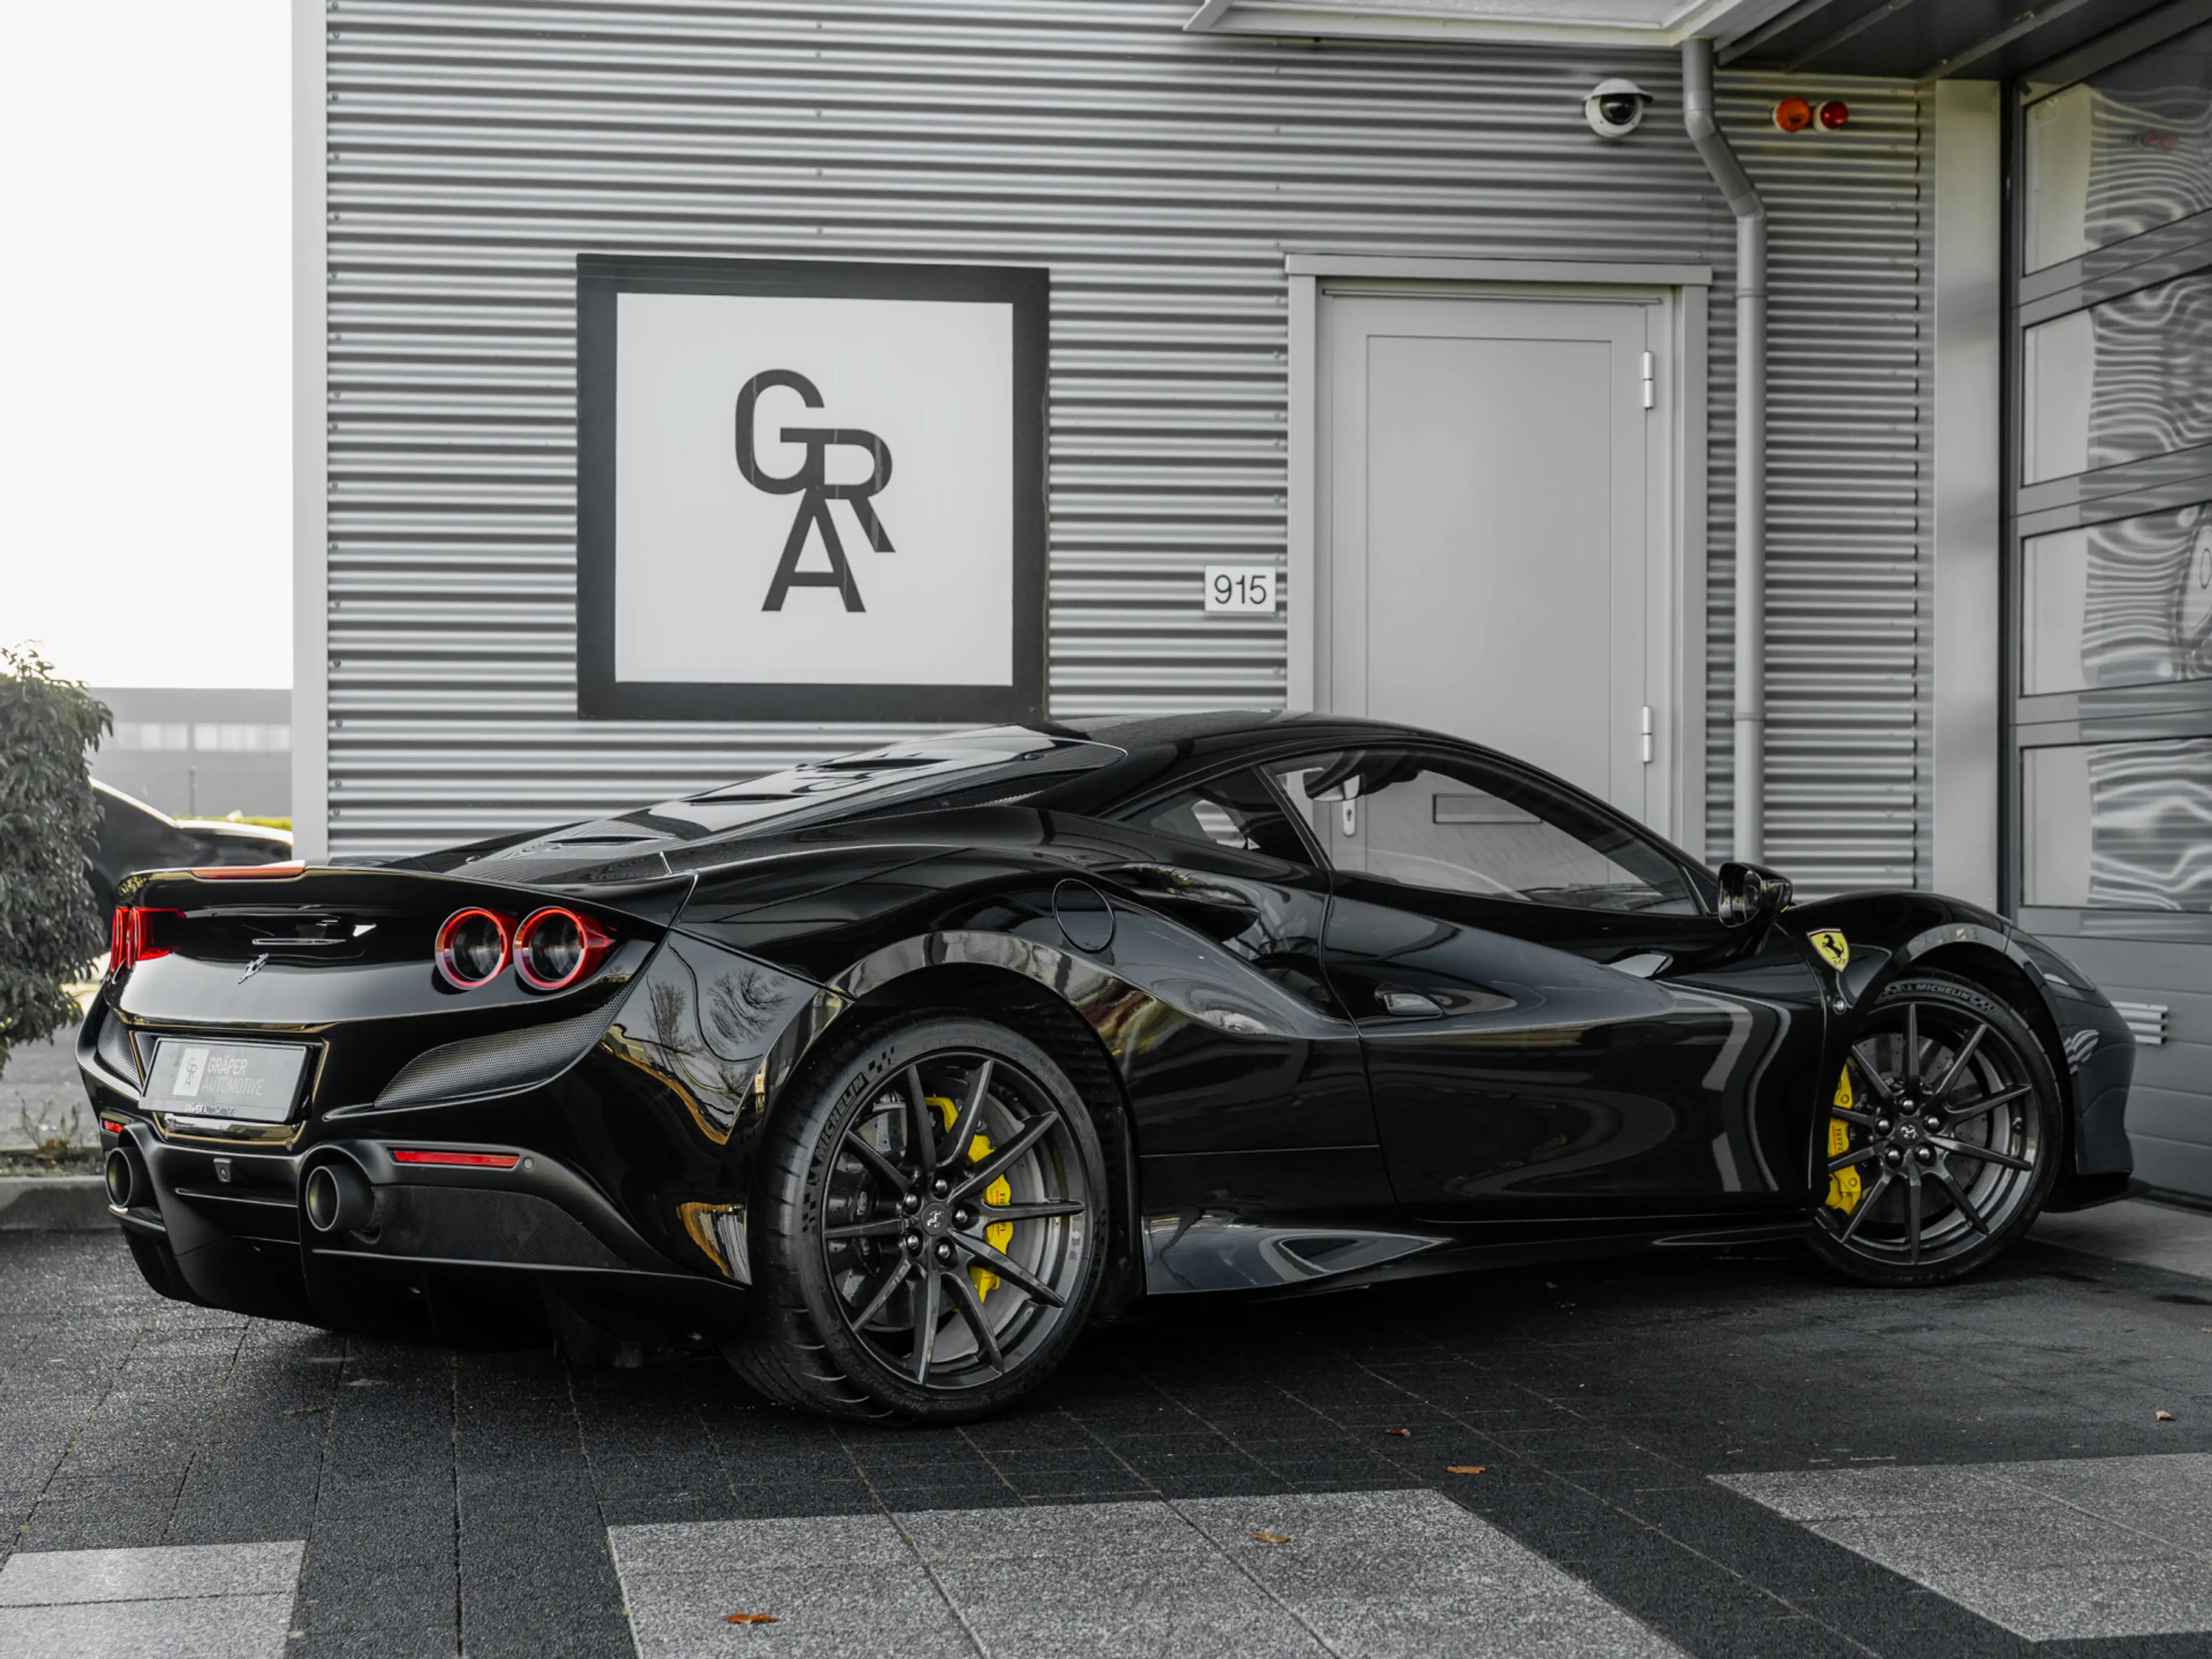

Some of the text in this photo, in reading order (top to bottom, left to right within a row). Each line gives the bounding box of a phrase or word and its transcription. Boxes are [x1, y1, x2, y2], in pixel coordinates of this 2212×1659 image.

[1214, 574, 1266, 605] 915
[1916, 984, 1971, 1000] MICHELIN
[207, 1055, 248, 1075] GRÄPER
[200, 1076, 265, 1095] AUTOMOTIVE
[815, 1073, 865, 1162] MICHELIN
